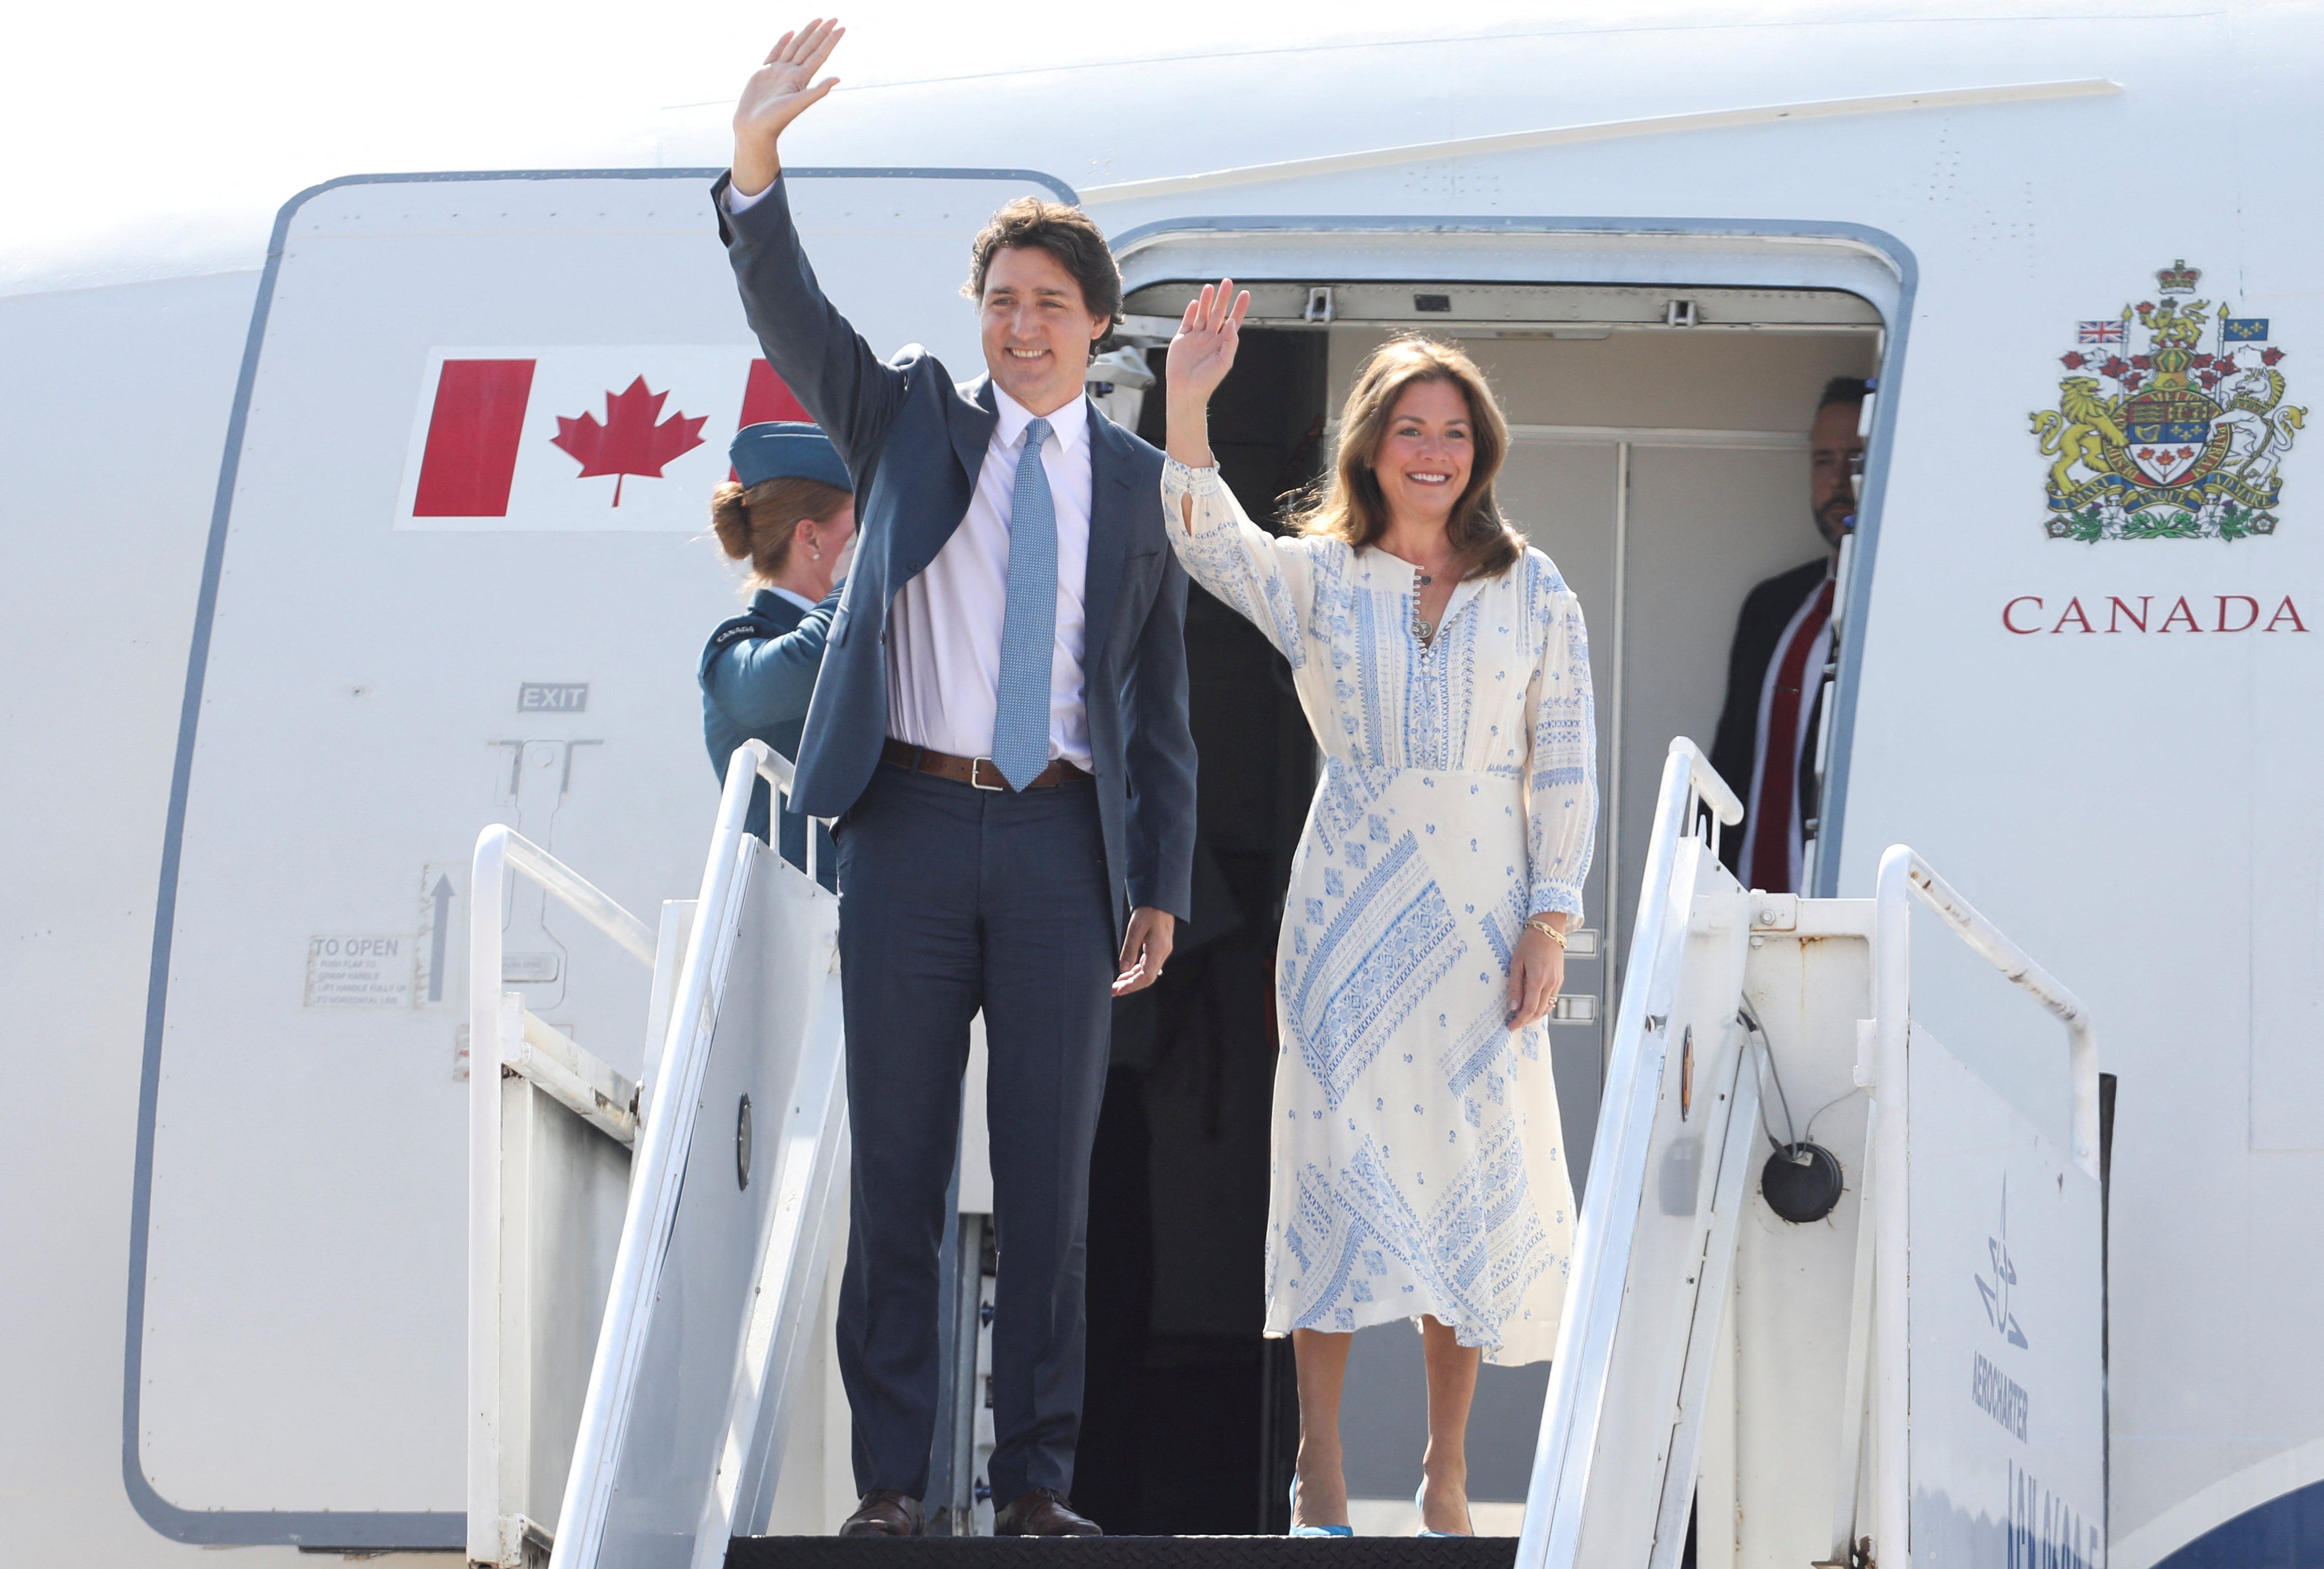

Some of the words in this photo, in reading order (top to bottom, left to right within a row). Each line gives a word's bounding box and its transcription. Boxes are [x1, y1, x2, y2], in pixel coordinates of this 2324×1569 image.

[2059, 499, 2068, 508] A
[2070, 478, 2109, 505] MARI
[2139, 489, 2185, 505] USQUE
[2212, 473, 2234, 487] AD
[2234, 483, 2269, 508] MARE
[2001, 595, 2310, 634] CANADA
[717, 626, 755, 643] CANADA
[523, 687, 585, 707] EXIT
[314, 939, 340, 956] TO
[346, 939, 399, 957] OPEN
[1972, 1349, 2028, 1444] AEROCHARTER
